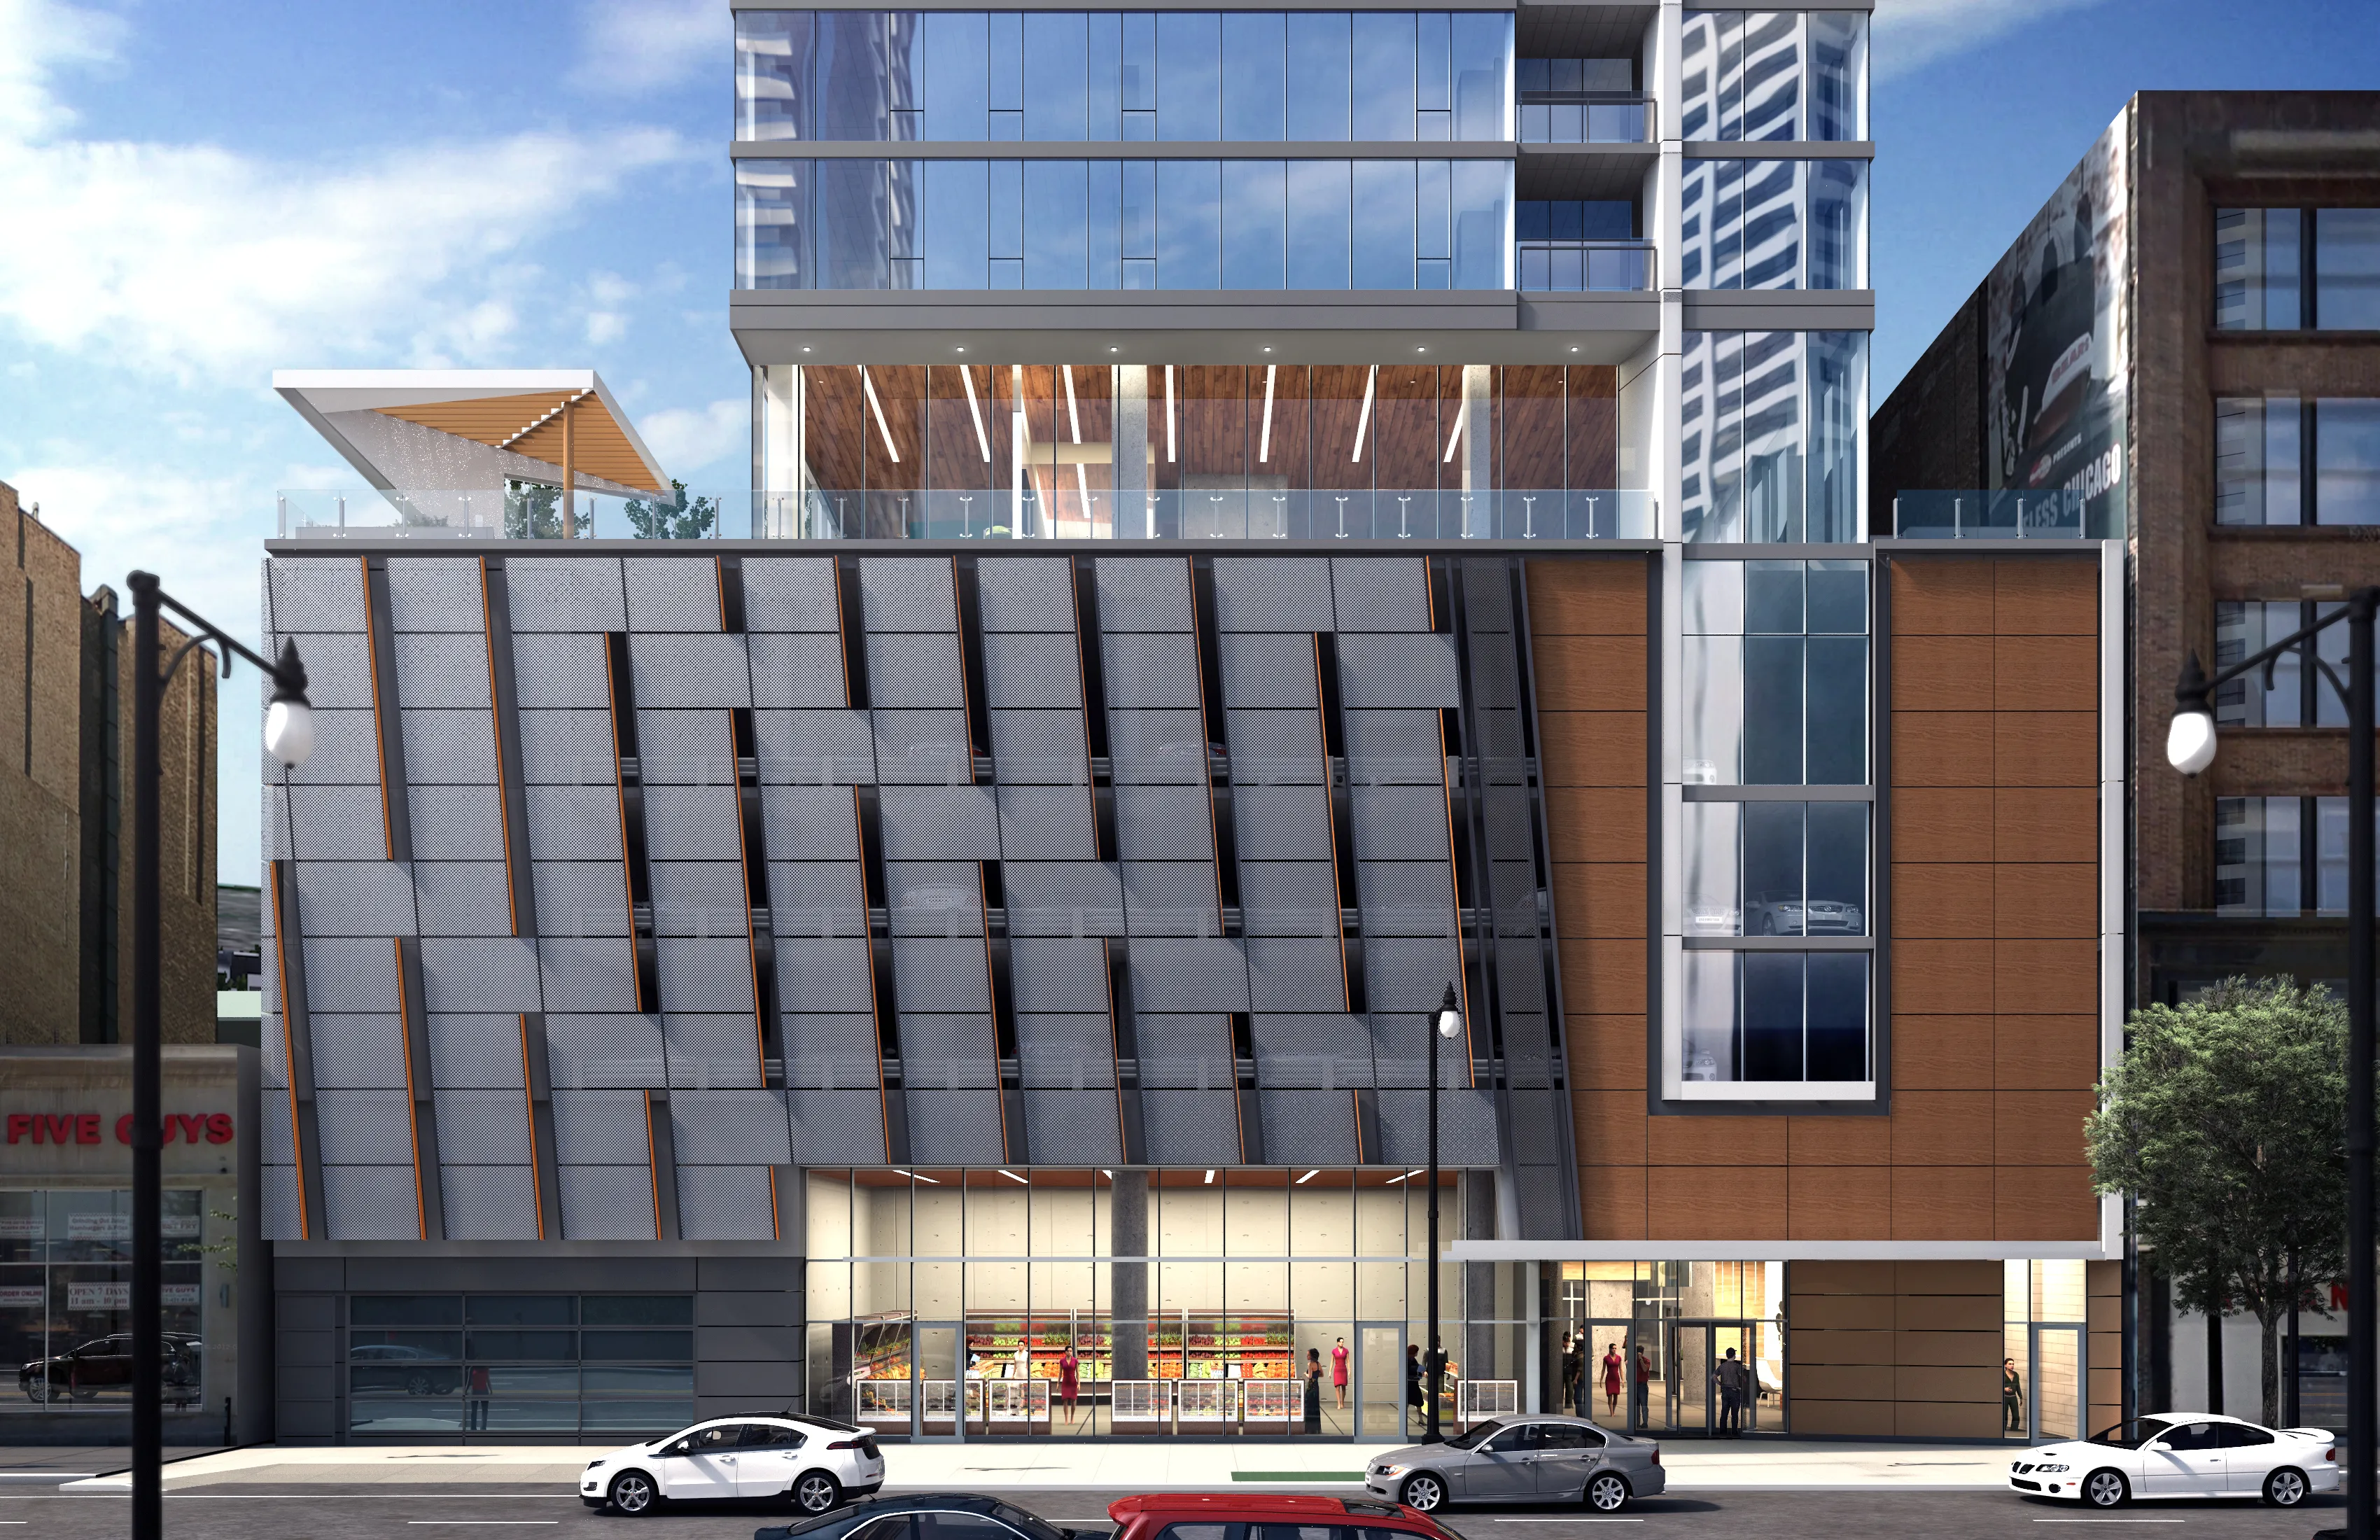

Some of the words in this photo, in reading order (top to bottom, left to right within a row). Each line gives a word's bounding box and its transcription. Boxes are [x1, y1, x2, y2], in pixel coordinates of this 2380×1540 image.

[2052, 432, 2082, 465] PRESENTS
[2063, 443, 2121, 517] CHICAGO
[7, 1114, 102, 1144] FIVE
